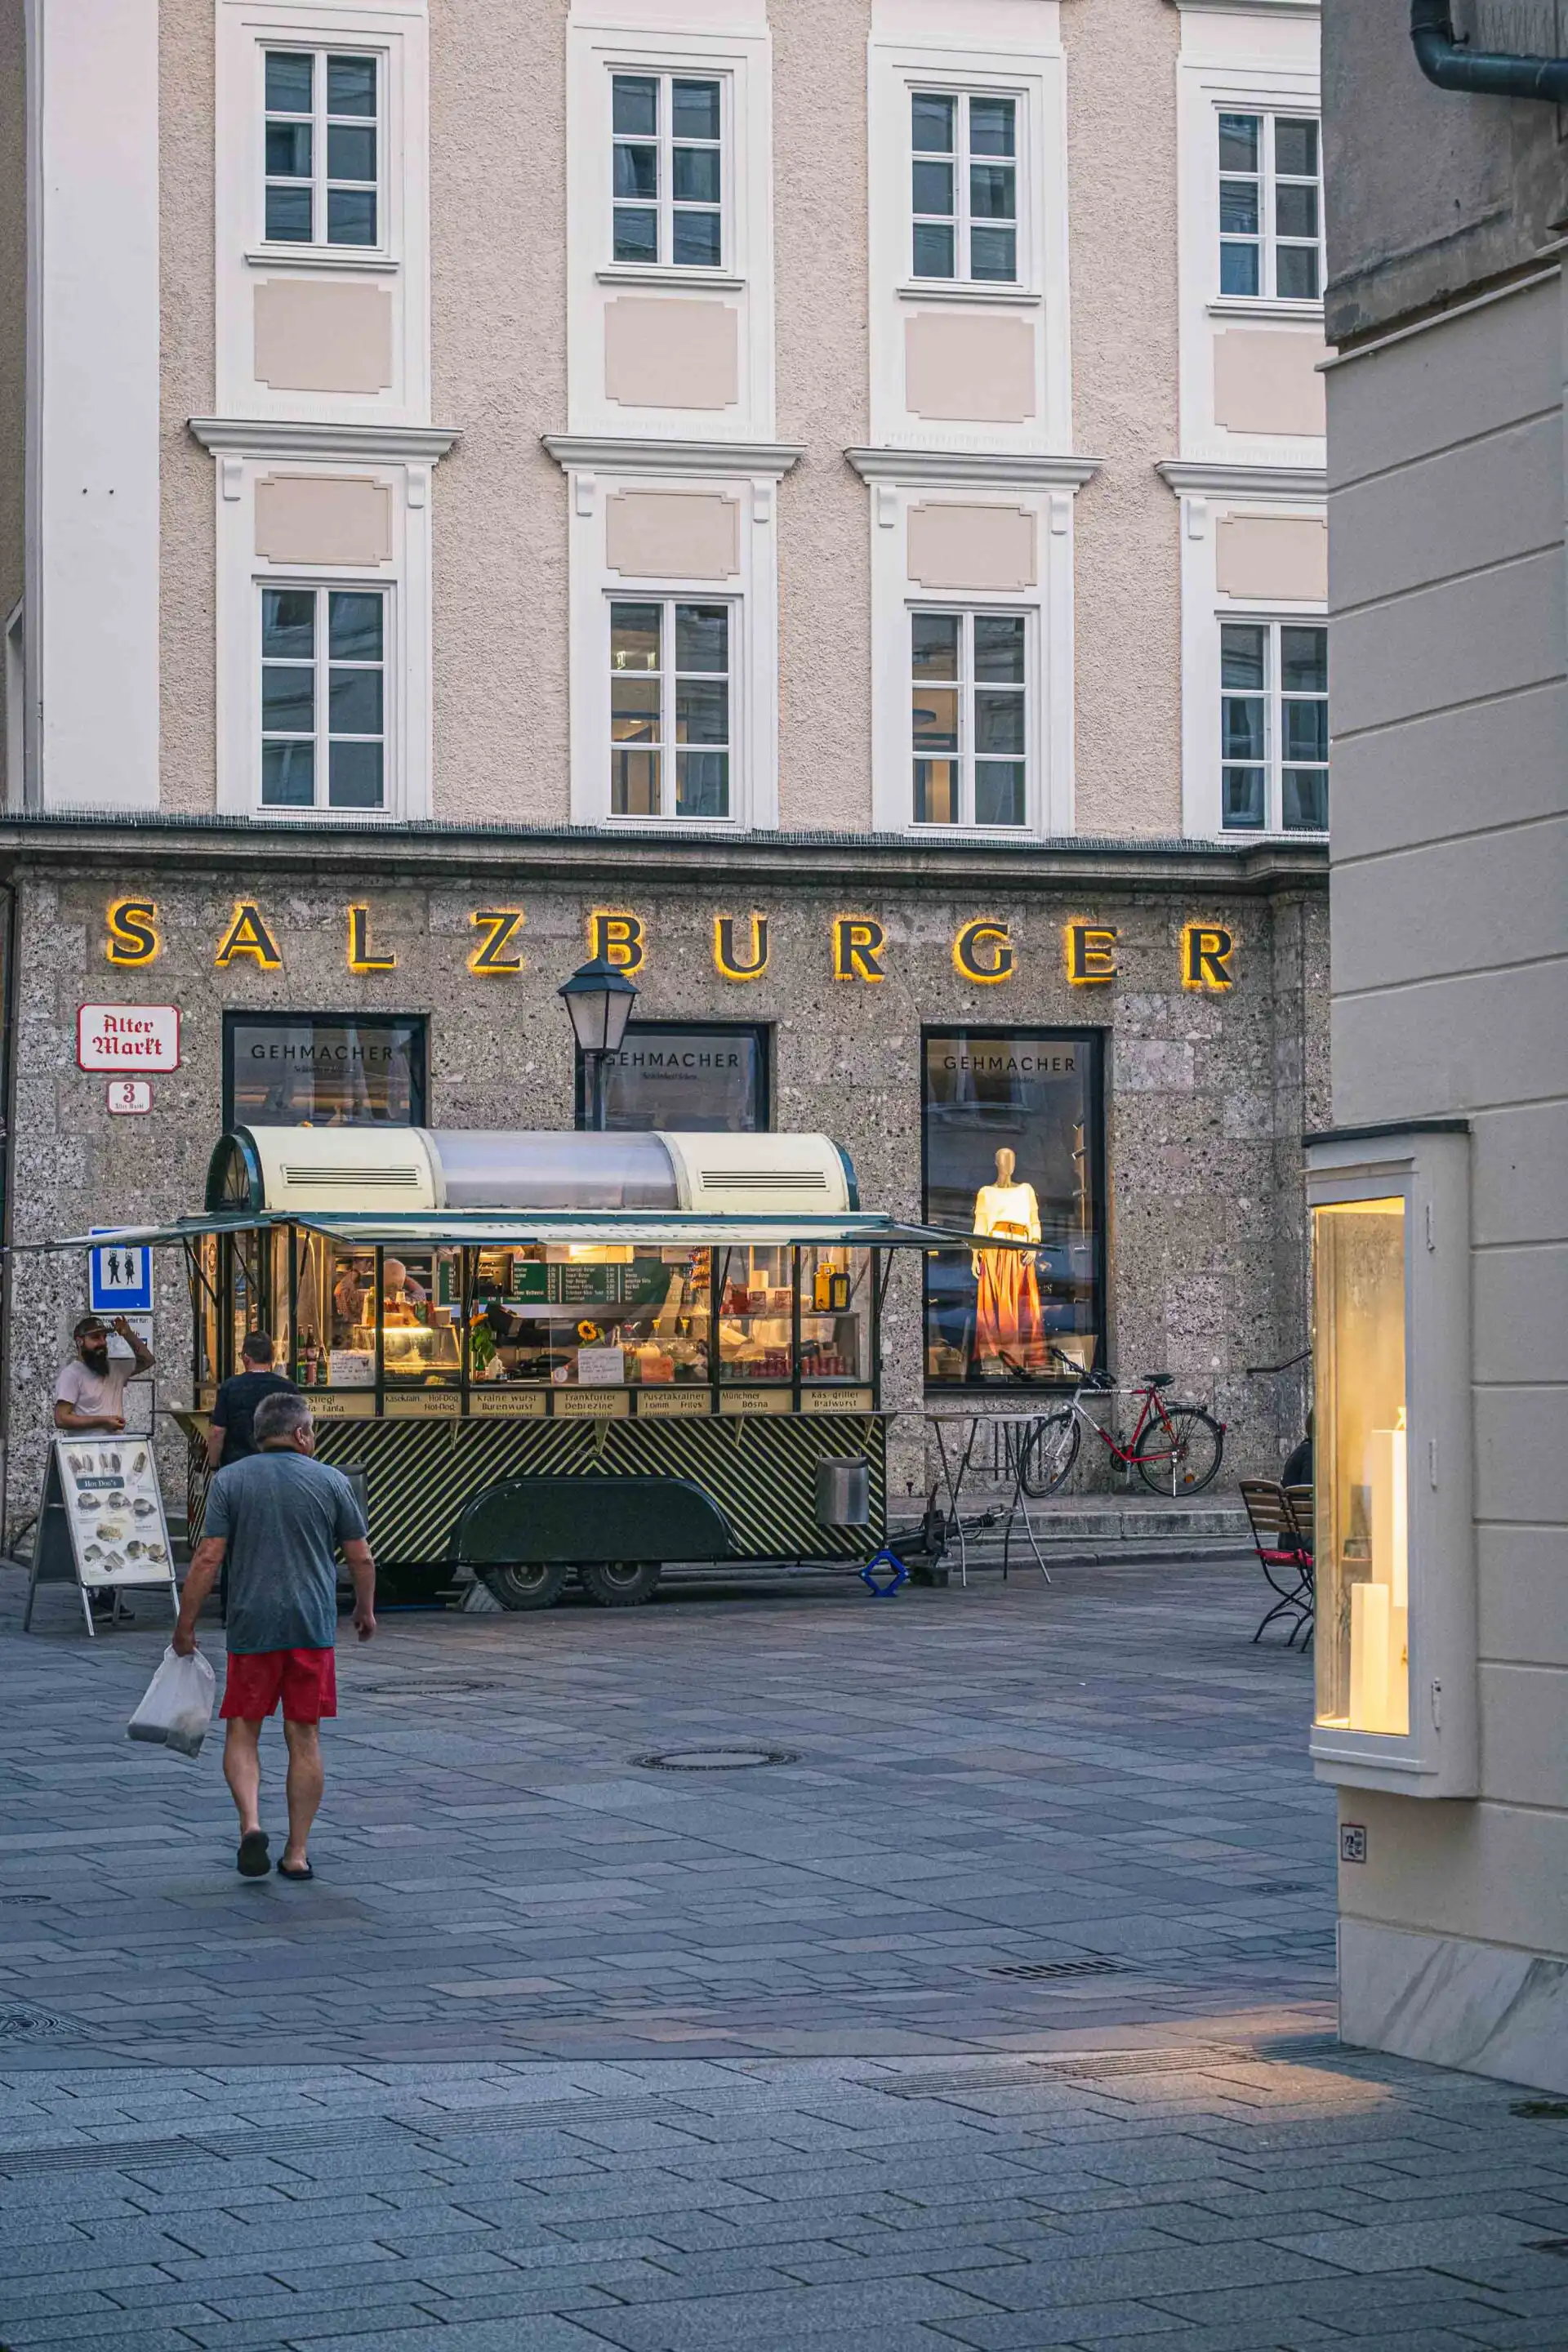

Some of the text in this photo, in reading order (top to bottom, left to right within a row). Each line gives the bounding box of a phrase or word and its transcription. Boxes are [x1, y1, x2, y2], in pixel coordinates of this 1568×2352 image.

[106, 900, 1235, 991] SALZBURGER
[104, 1014, 154, 1033] Alter
[92, 1036, 163, 1055] Markt
[252, 1045, 393, 1060] GEHMACHER
[604, 1052, 738, 1067] GEHMACHER
[944, 1056, 1076, 1071] GEHMACHER
[122, 1083, 135, 1102] 3
